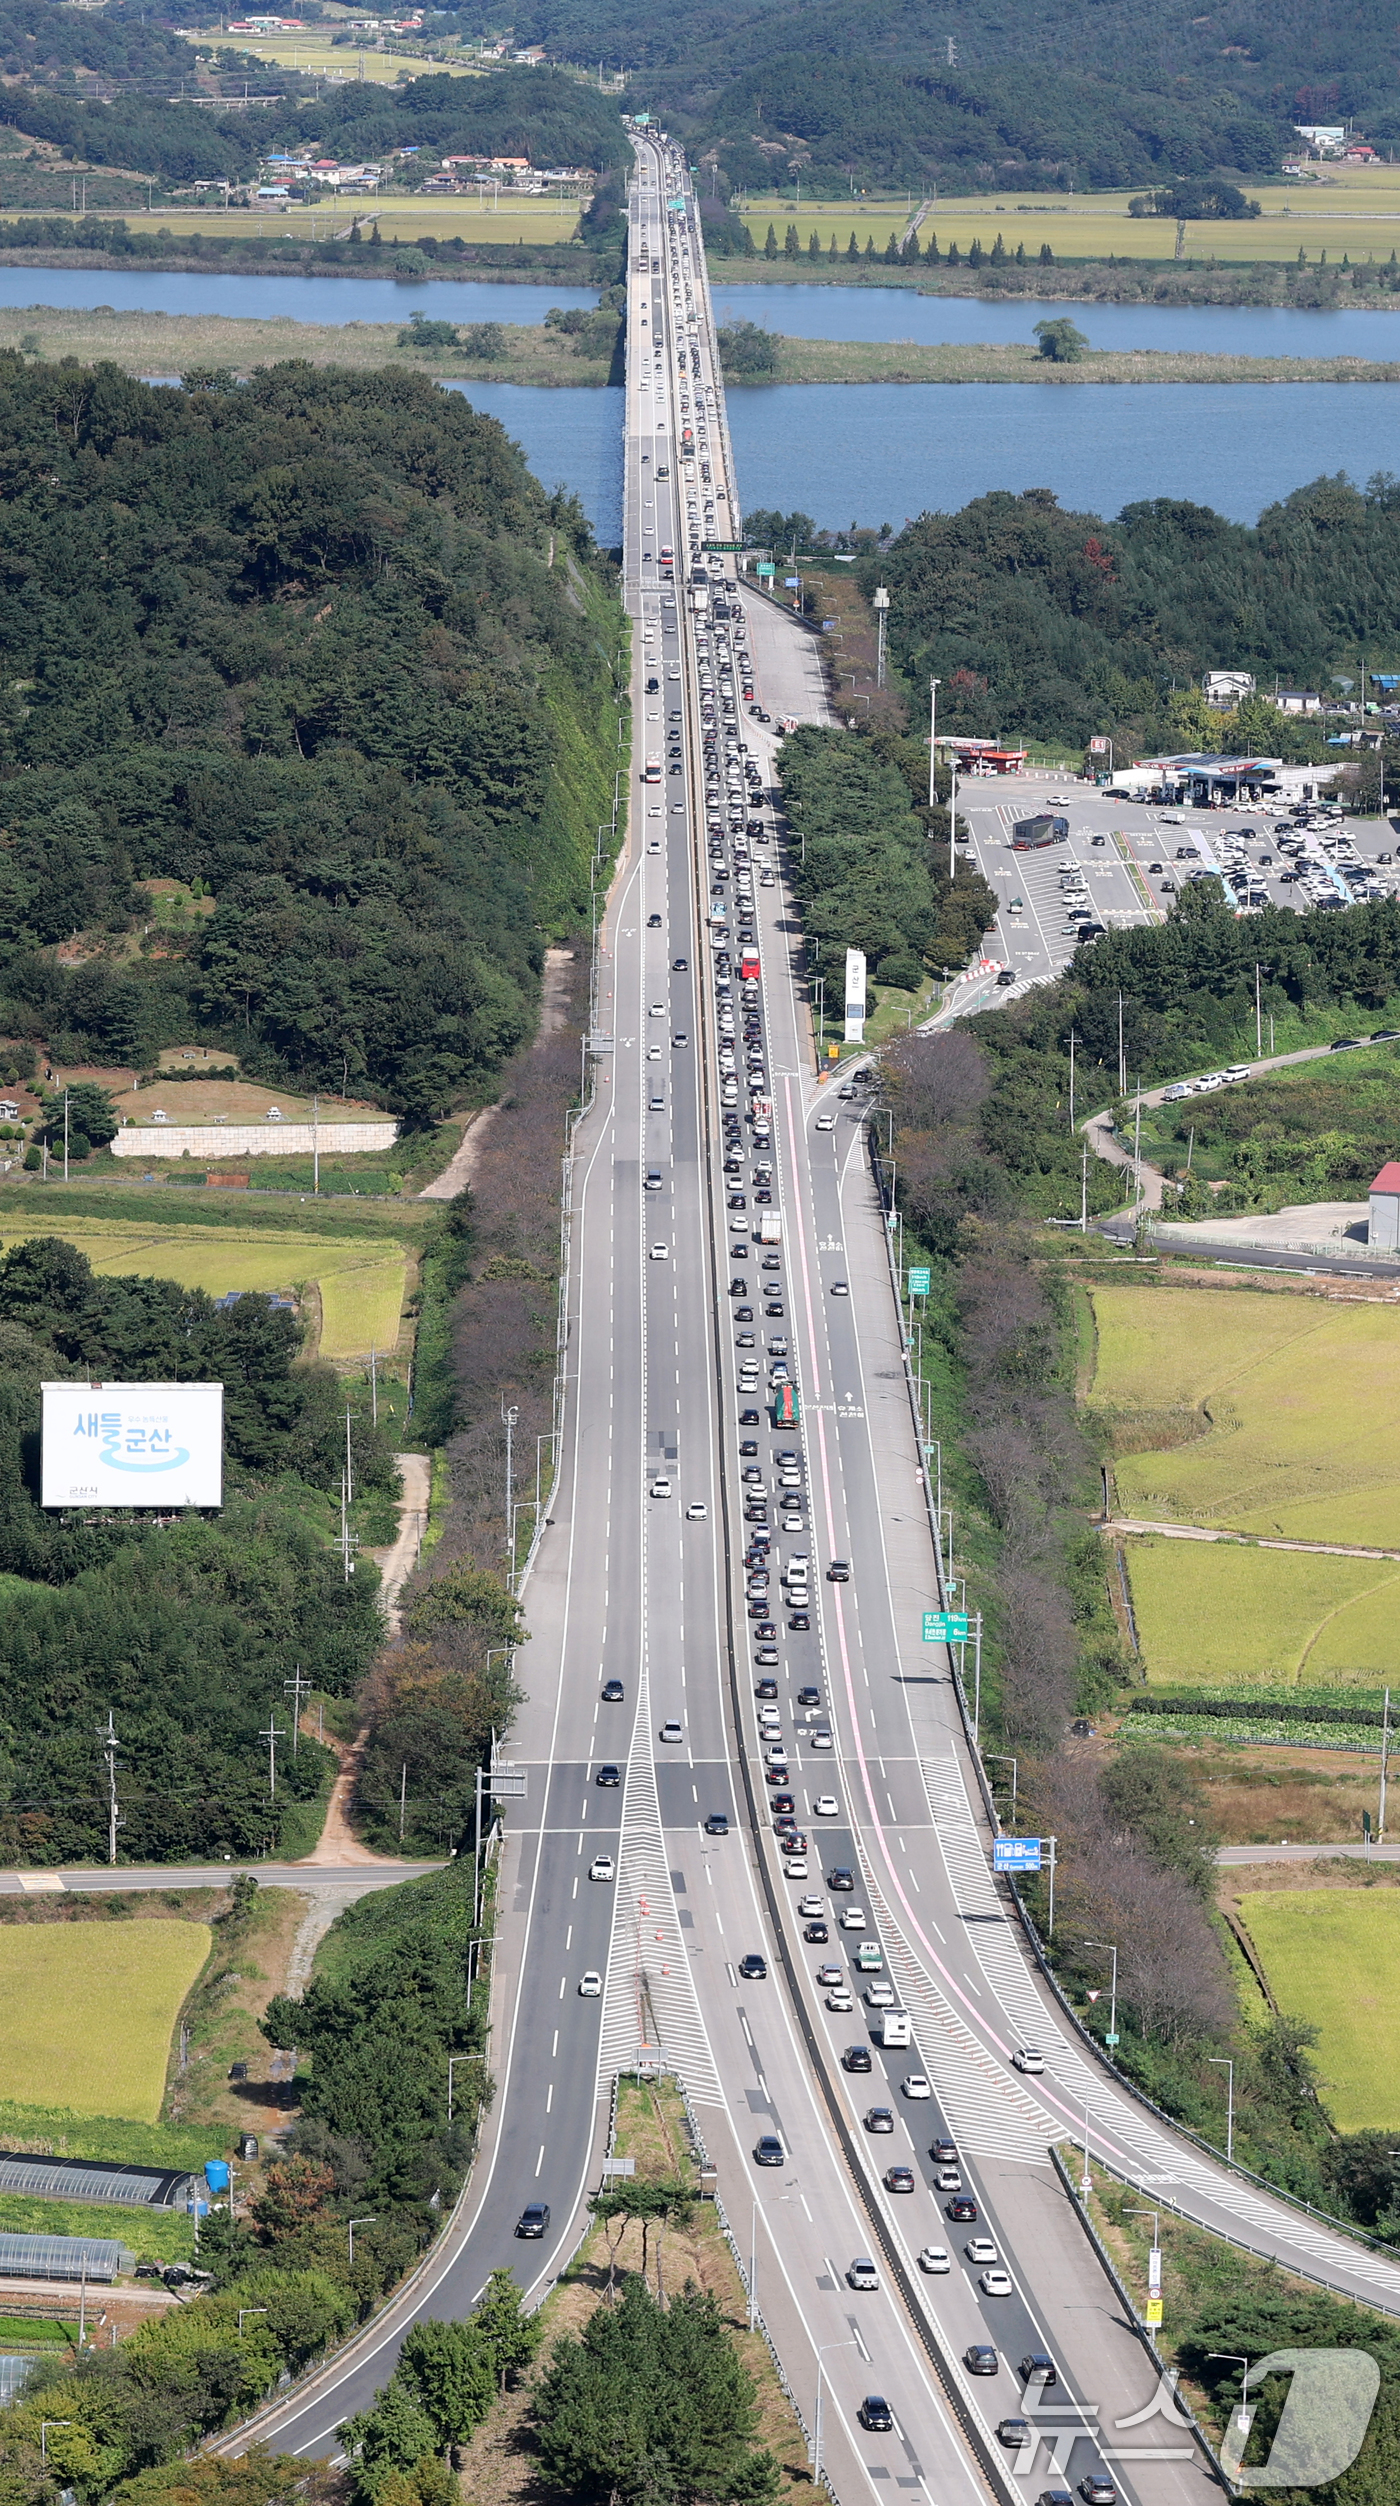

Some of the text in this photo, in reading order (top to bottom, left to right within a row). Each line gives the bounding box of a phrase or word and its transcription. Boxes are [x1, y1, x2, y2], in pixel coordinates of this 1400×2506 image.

[73, 1413, 122, 1449] 새들
[125, 1429, 172, 1452] 군산
[69, 1486, 98, 1494] 군산시
[947, 1614, 967, 1622] 119km
[953, 1628, 967, 1636] 6km
